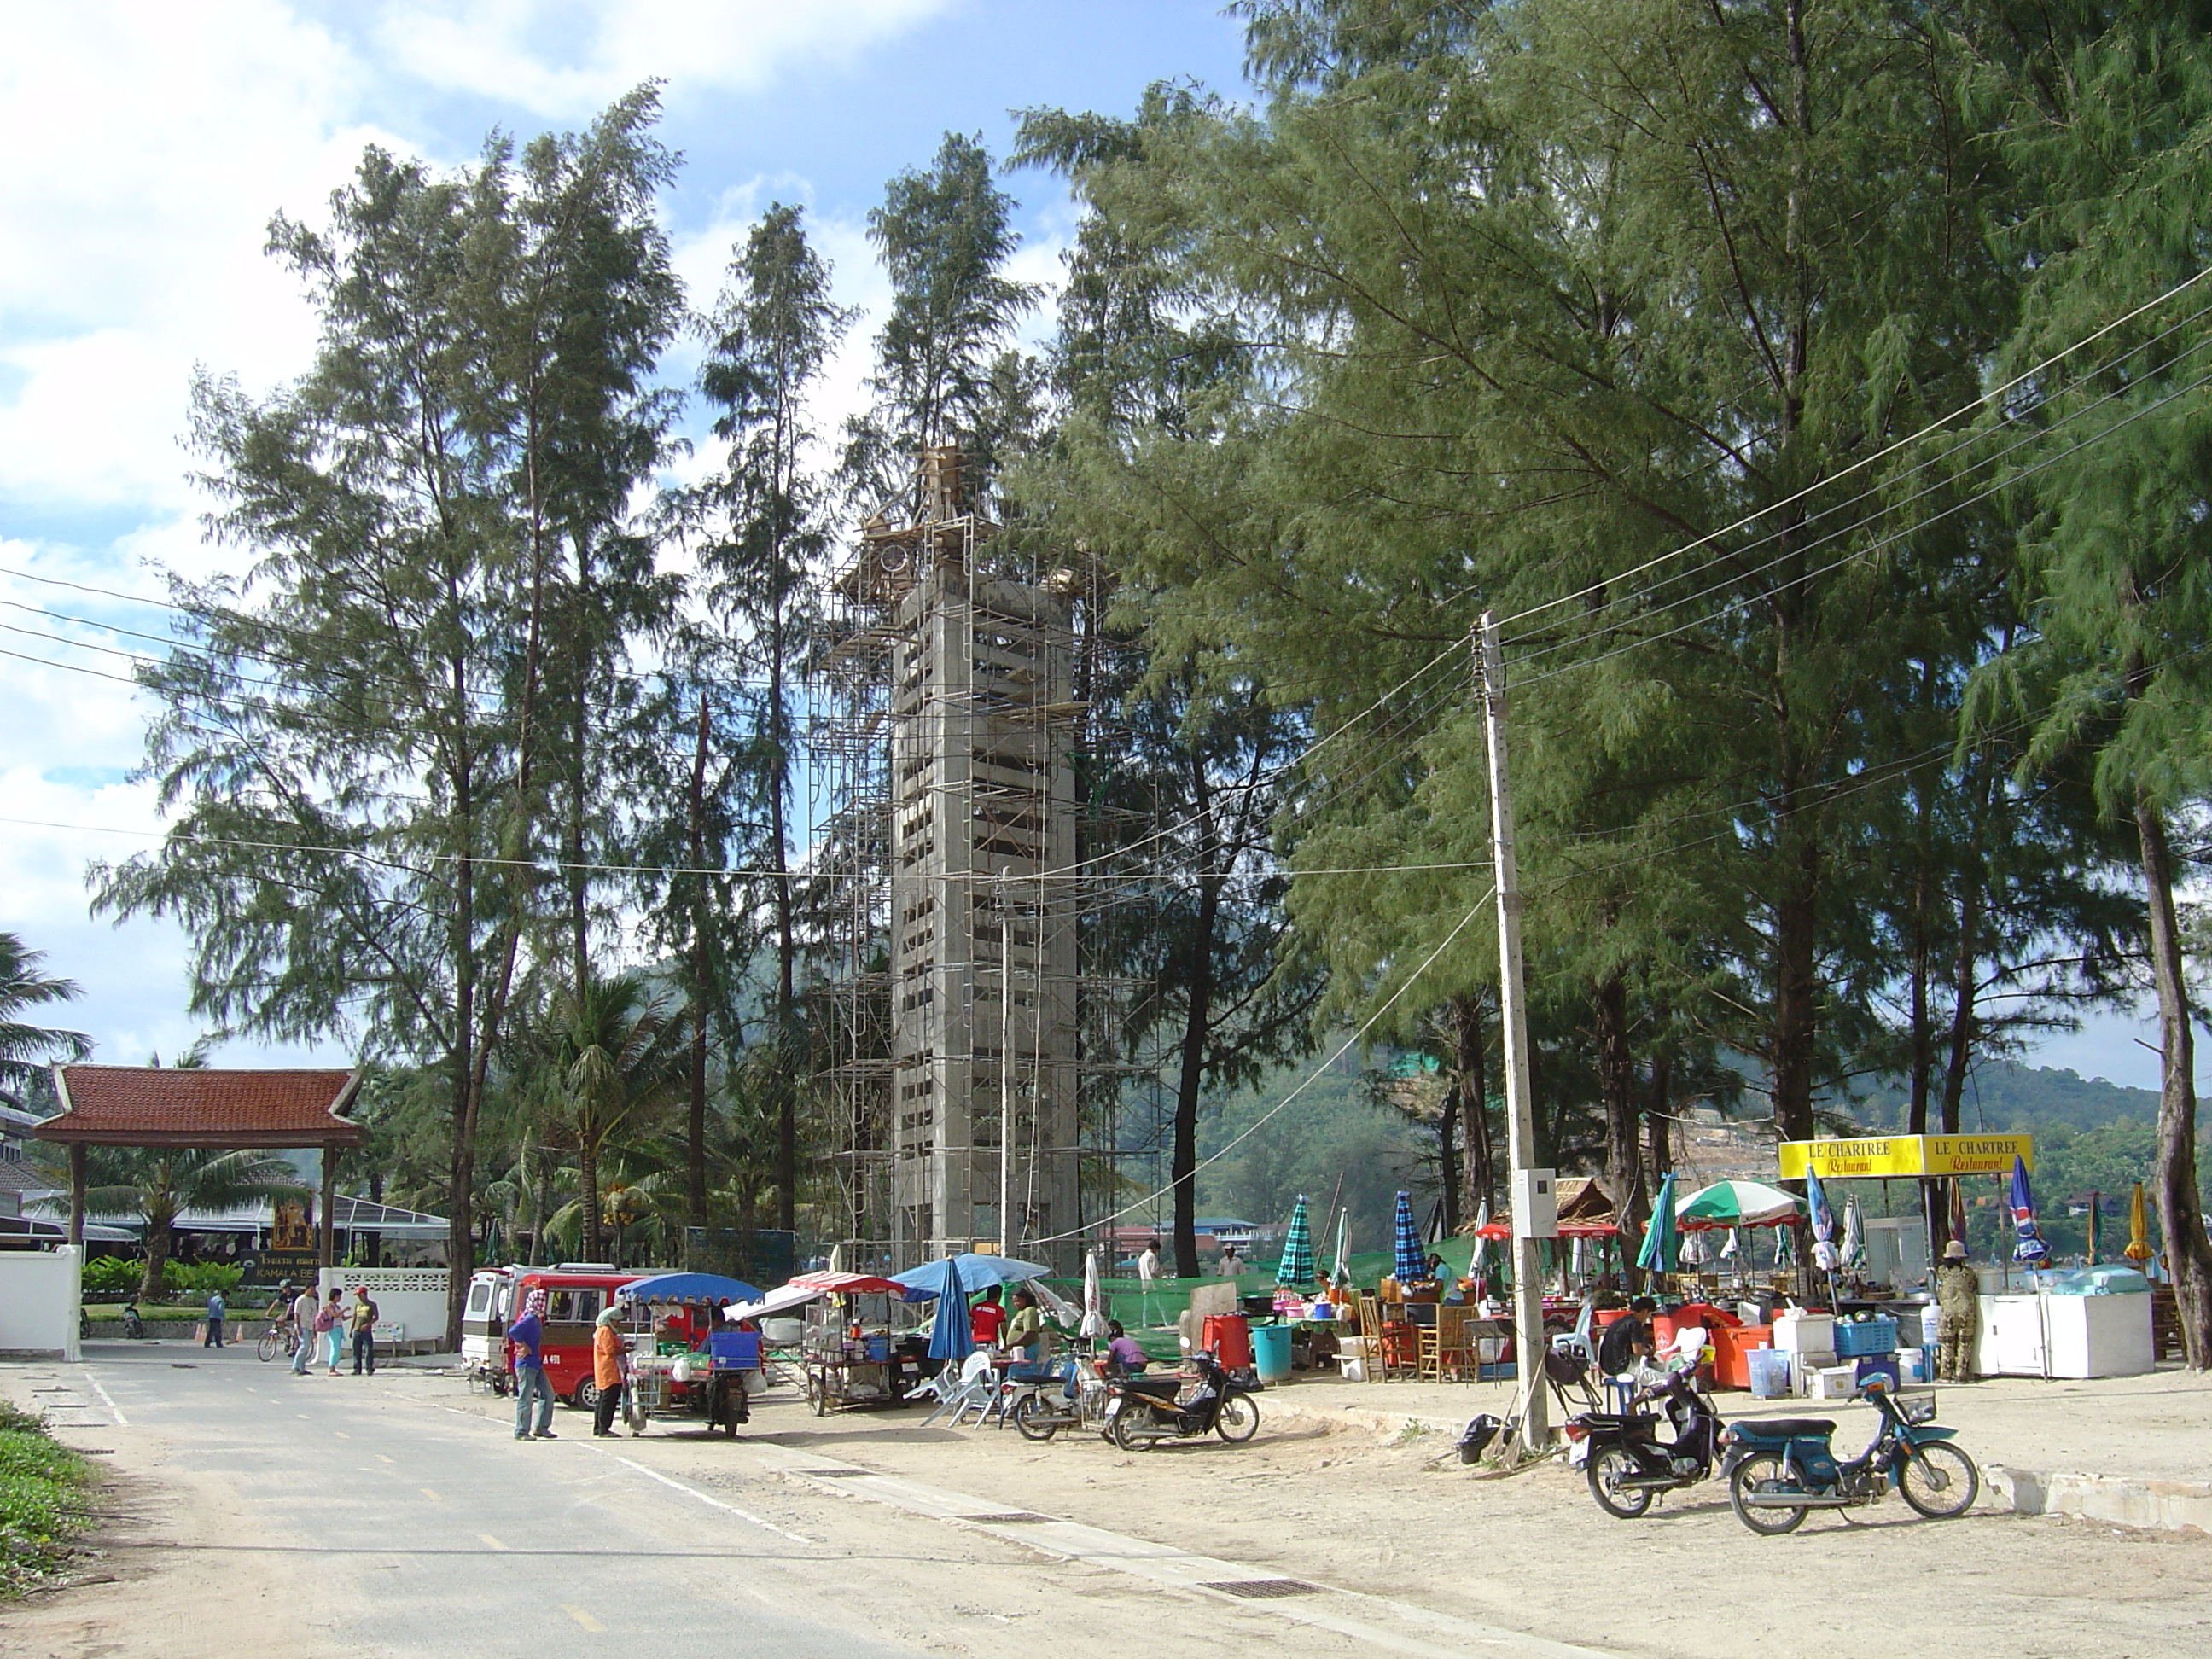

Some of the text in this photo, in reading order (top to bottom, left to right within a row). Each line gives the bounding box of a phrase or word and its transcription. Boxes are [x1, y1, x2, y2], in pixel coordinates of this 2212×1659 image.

[1808, 1141, 1890, 1158] LE CHARTREE
[1935, 1140, 2019, 1155] LE CHARTREE
[1828, 1158, 1872, 1173] Restaurant
[1950, 1155, 2003, 1171] Restaurant
[256, 1268, 297, 1278] KAMALA
